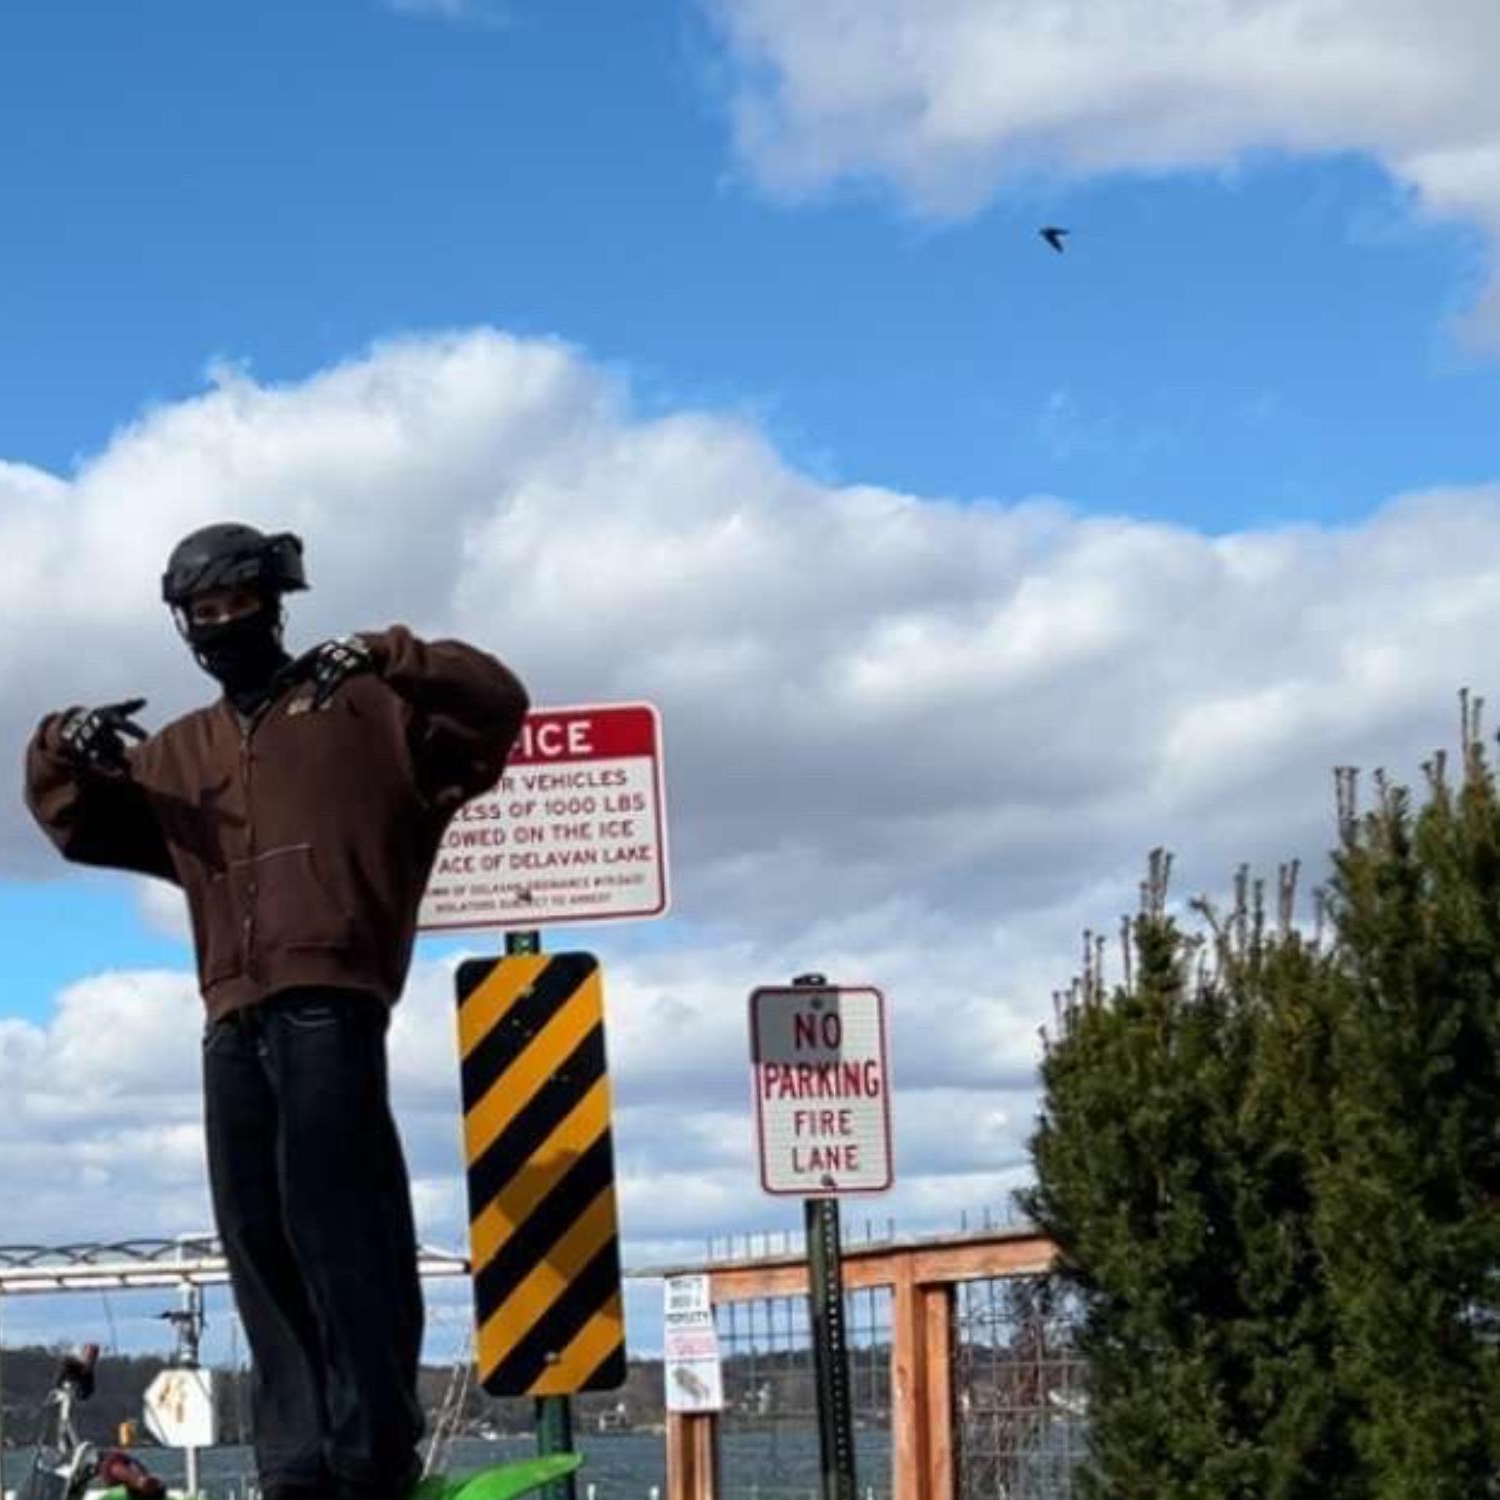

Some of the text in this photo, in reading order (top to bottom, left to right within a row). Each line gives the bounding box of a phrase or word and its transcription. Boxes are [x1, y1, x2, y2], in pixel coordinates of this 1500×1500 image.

[513, 720, 593, 757] ICE
[521, 768, 627, 792] VEHICLES
[454, 792, 646, 822] ESS OF 1000 LBS
[514, 826, 544, 844] ON
[552, 821, 593, 841] THE
[600, 819, 634, 838] ICE
[481, 853, 505, 872] OF
[509, 848, 598, 870] DELAVAN
[603, 844, 651, 863] LAKE
[794, 1012, 842, 1050] NO
[763, 1059, 880, 1100] PARKING
[793, 1108, 854, 1138] FIRE
[791, 1144, 860, 1173] LANE
